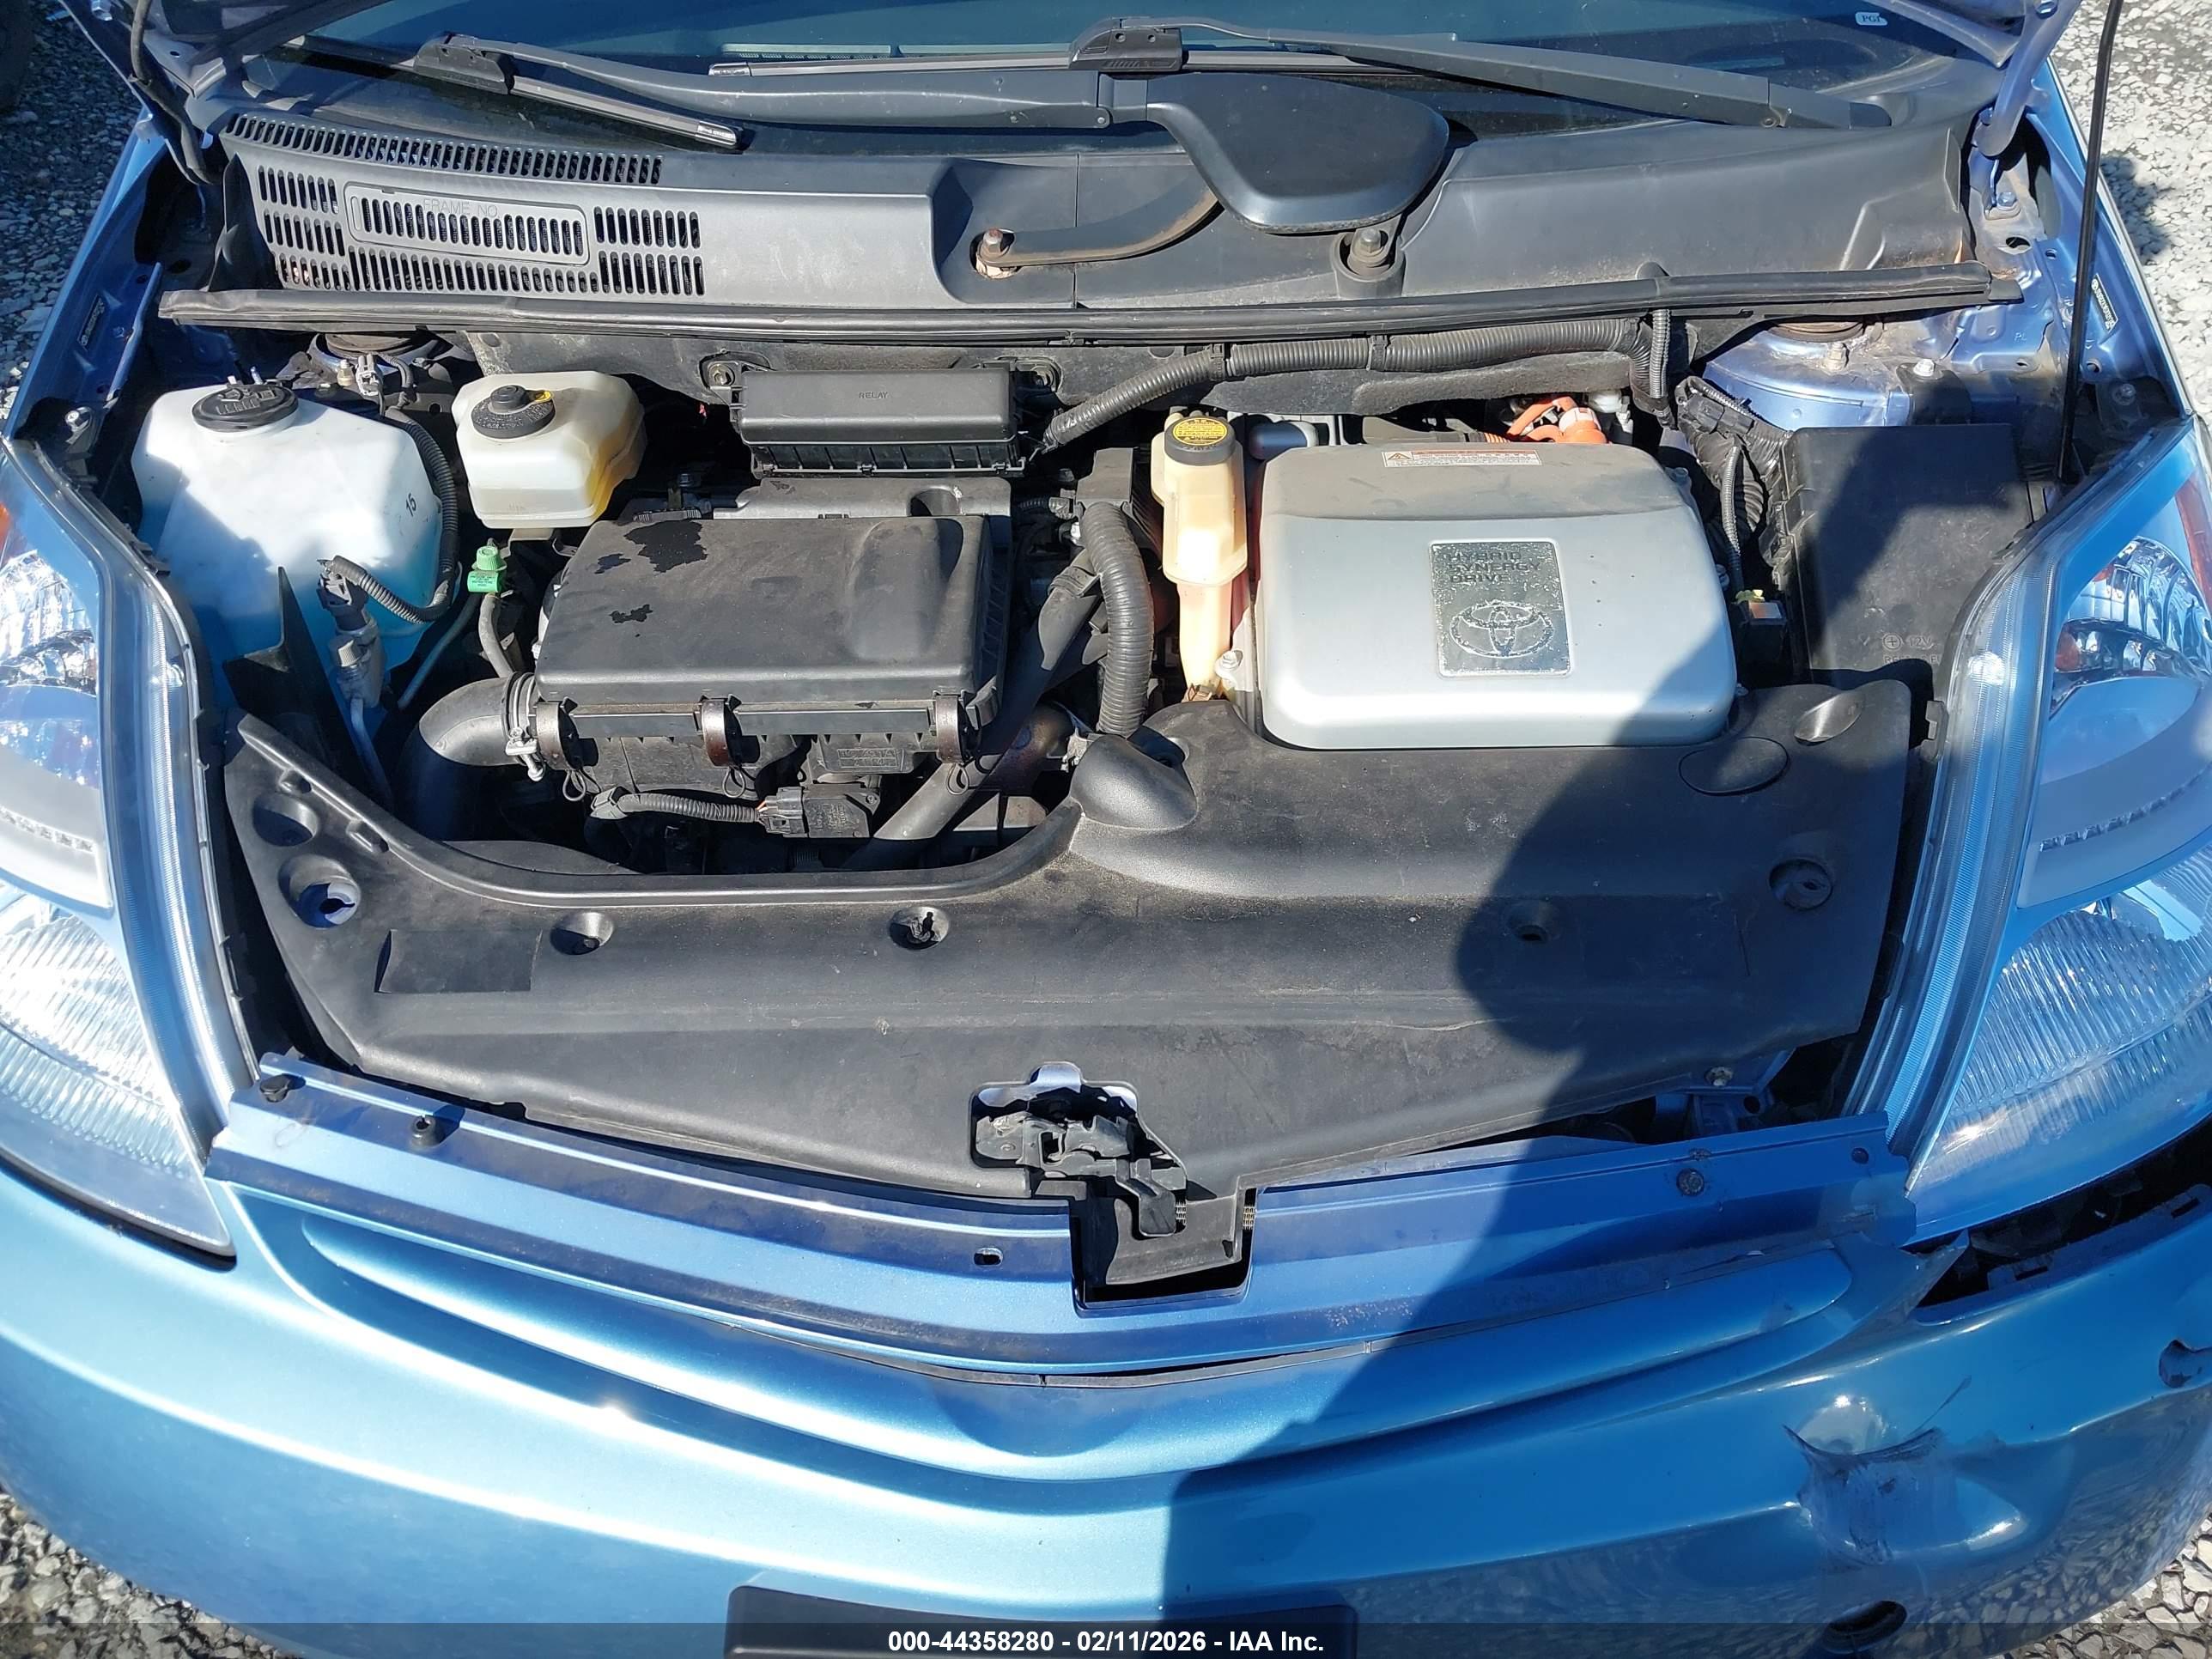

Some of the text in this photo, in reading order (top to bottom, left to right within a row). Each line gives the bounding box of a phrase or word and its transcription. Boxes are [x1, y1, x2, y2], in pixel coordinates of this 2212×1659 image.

[422, 198, 471, 216] FRAME
[1448, 550, 1522, 561] HYBRID
[1449, 562, 1541, 571] SYNERGY
[1449, 574, 1511, 583] DRIVE
